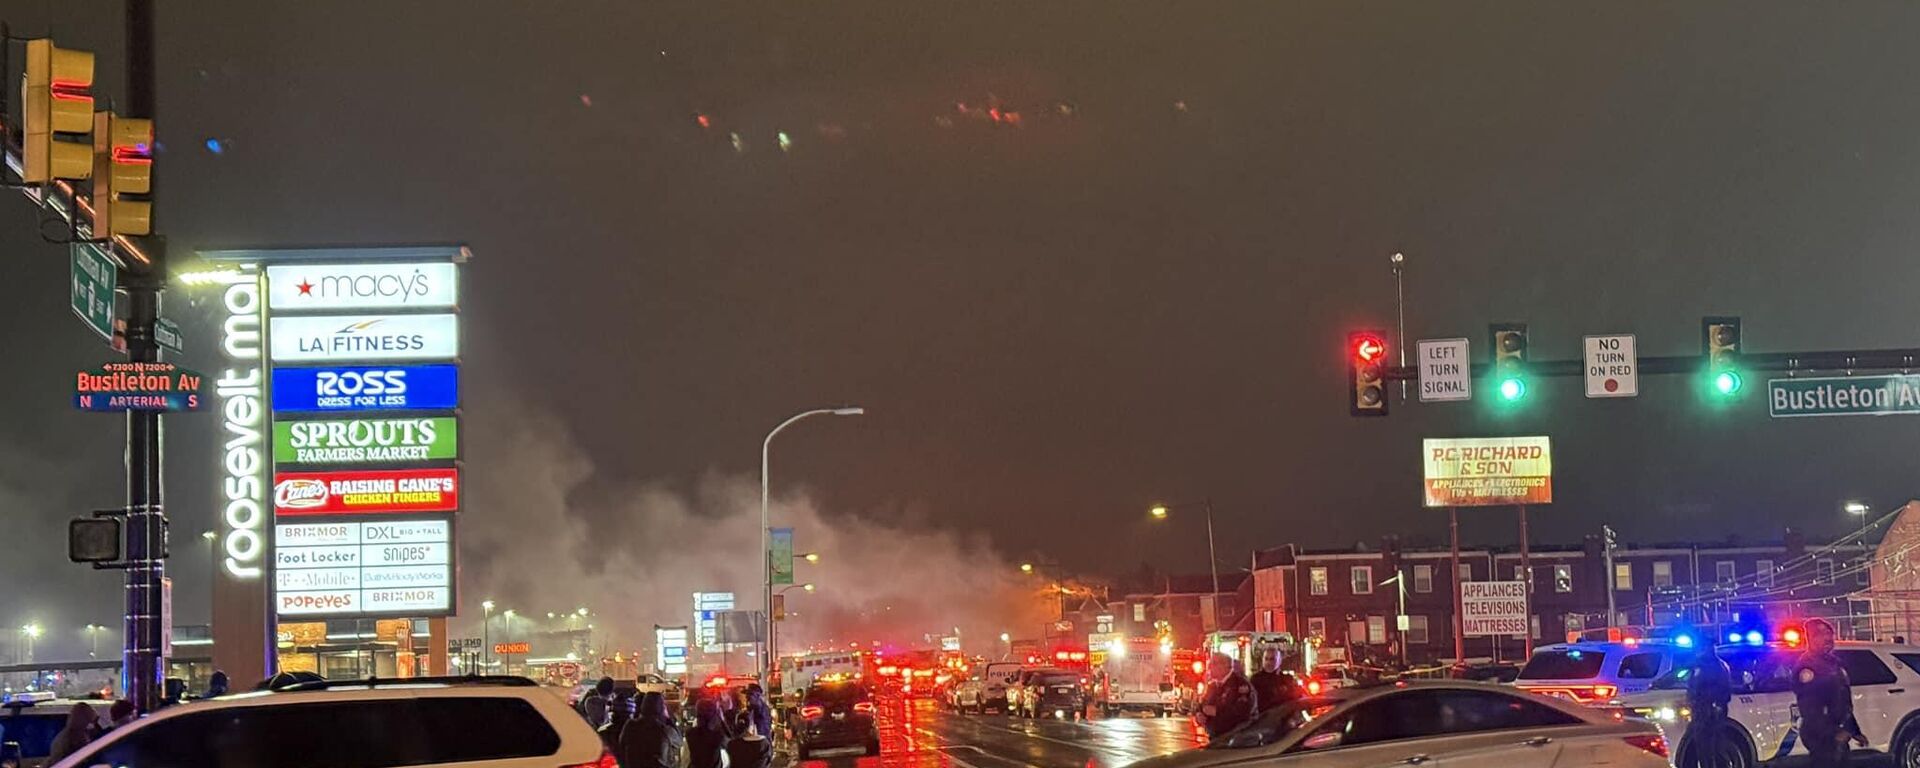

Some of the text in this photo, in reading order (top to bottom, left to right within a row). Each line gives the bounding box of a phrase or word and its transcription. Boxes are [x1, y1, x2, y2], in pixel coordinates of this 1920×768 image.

[321, 268, 429, 303] macy's
[299, 335, 424, 352] LA FITNESS
[1599, 338, 1620, 350] NO
[1429, 346, 1456, 359] LEFT
[1596, 352, 1625, 363] TURN
[134, 363, 144, 372] N
[1430, 364, 1459, 376] TURN
[1590, 365, 1631, 376] ON RED
[77, 372, 199, 391] Bustleton Av
[316, 370, 407, 396] ROSS
[1424, 380, 1466, 393] SIGNAL
[80, 395, 198, 408] N ARTERIAL S
[317, 396, 406, 407] DRESS FOR LESS
[1773, 384, 1889, 411] Bustleton
[290, 418, 437, 448] SPROUTS
[297, 445, 429, 463] FARMERS MARKET
[1461, 446, 1542, 461] RICHARD
[217, 368, 259, 577] roosevelt
[1461, 461, 1512, 475] & SON
[330, 477, 454, 494] RAISING CANE'S
[343, 491, 441, 504] CHICKEN FINGERS
[285, 526, 348, 537] BRIXMOR
[366, 526, 400, 540] DXL
[278, 551, 356, 563] Foot Locker
[373, 591, 435, 602] BRIXMOR
[1464, 583, 1524, 597] APPLIANCES
[1464, 601, 1525, 615] TELEVISIONS
[1464, 618, 1526, 632] MATTRESSES
